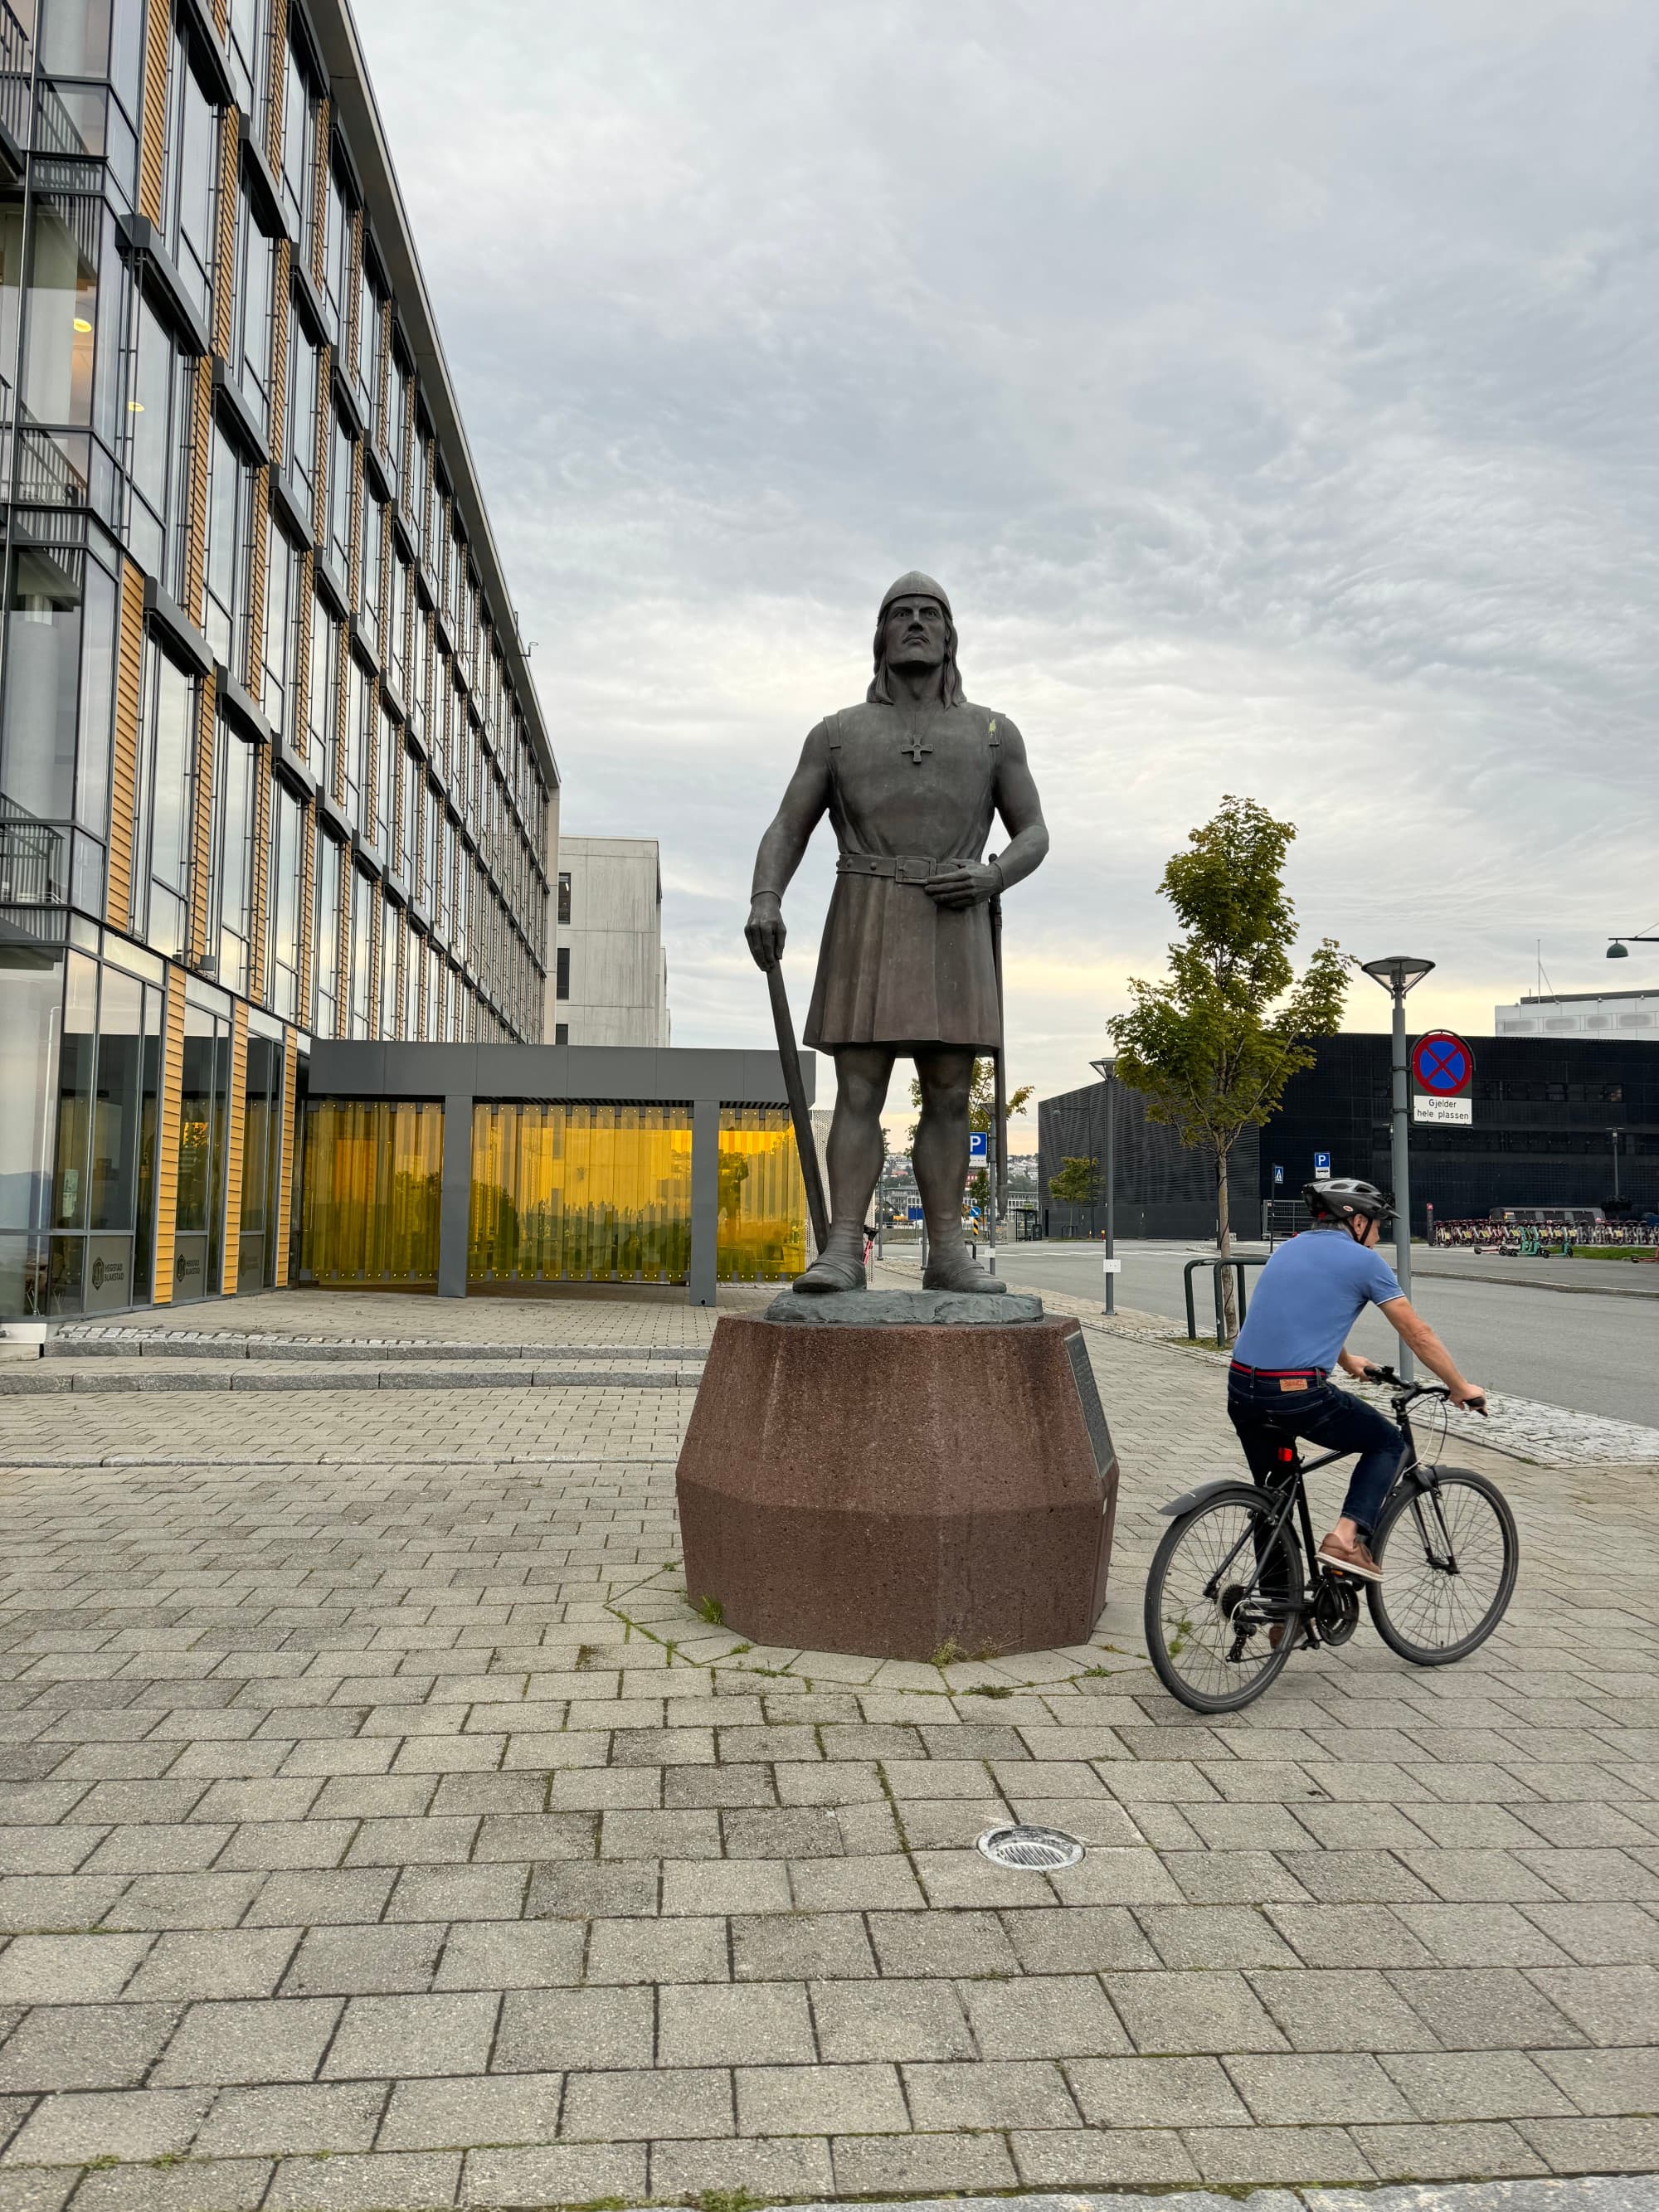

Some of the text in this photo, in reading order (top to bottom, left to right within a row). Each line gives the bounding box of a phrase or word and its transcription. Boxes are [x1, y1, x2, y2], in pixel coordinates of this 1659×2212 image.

[1428, 1098, 1457, 1109] Gjelder
[1417, 1109, 1469, 1120] hele plassen
[970, 1135, 981, 1153] P
[1318, 1155, 1326, 1166] P
